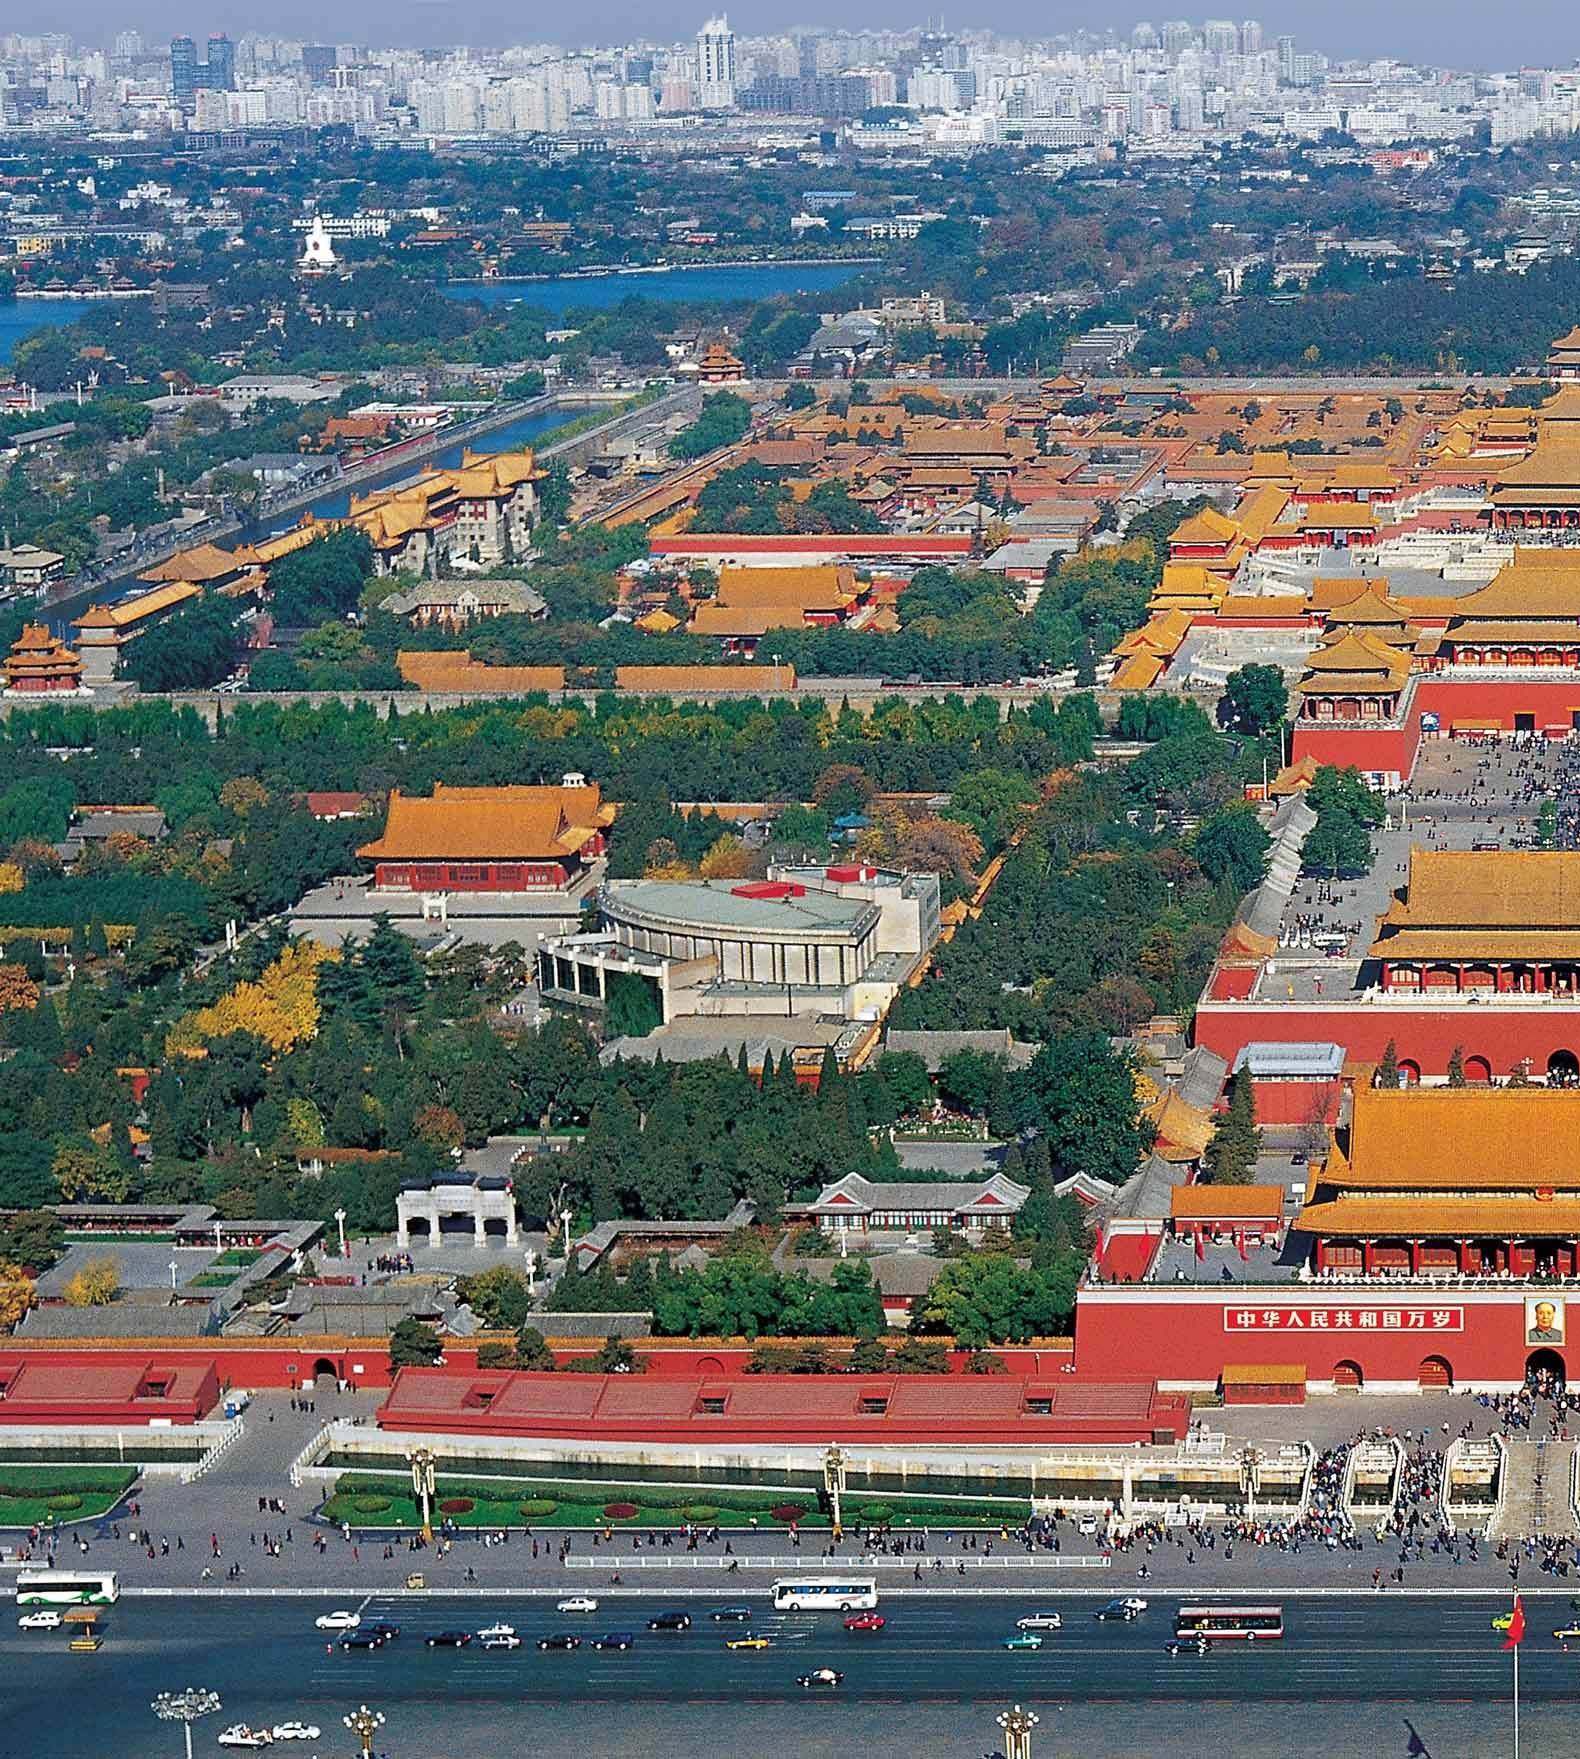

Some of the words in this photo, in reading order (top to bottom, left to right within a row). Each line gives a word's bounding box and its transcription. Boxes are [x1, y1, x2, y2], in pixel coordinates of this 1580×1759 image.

[1237, 1310, 1450, 1329] 中华人民共和国万岁
